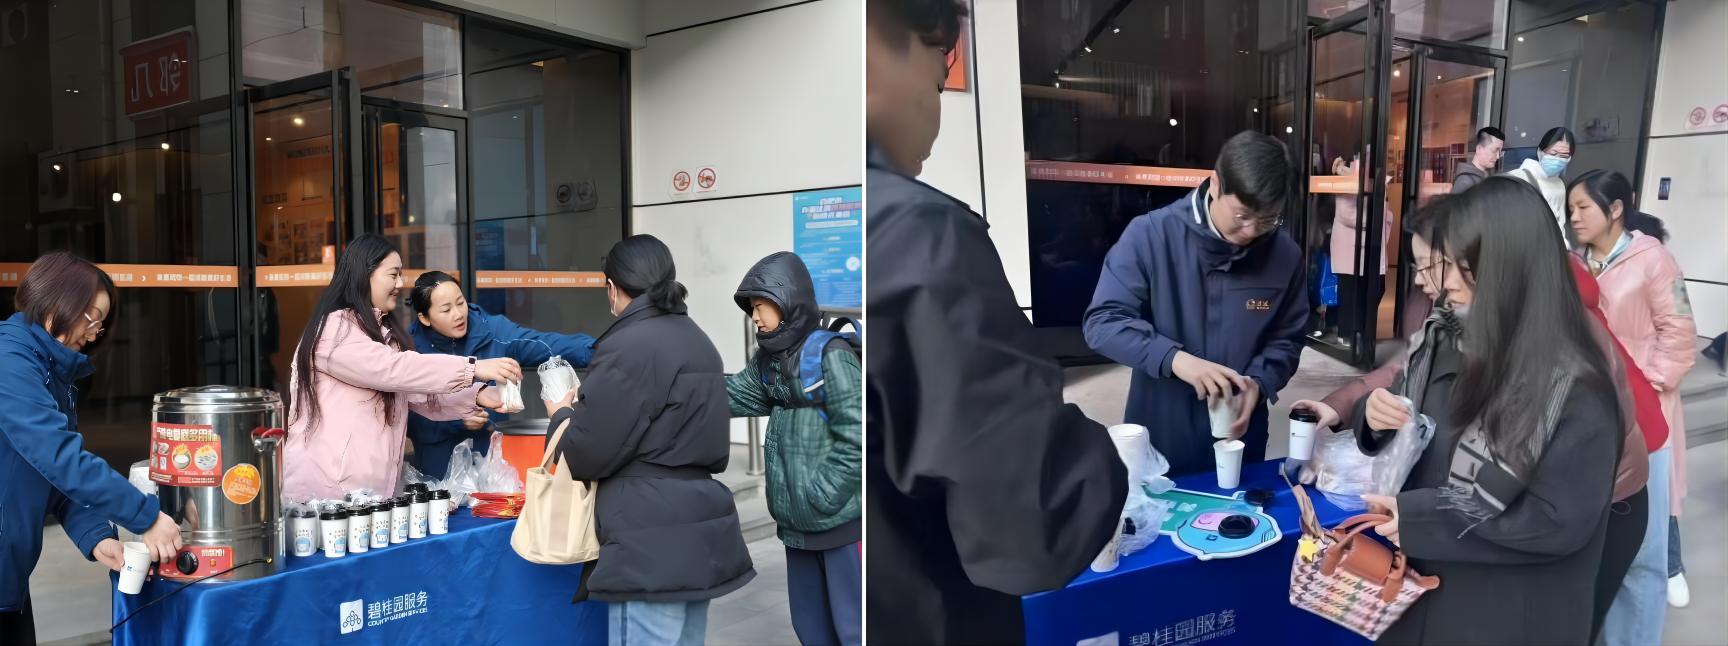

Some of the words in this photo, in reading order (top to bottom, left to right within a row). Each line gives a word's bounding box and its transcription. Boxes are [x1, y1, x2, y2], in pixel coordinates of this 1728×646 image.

[367, 590, 428, 620] 碧桂园服务
